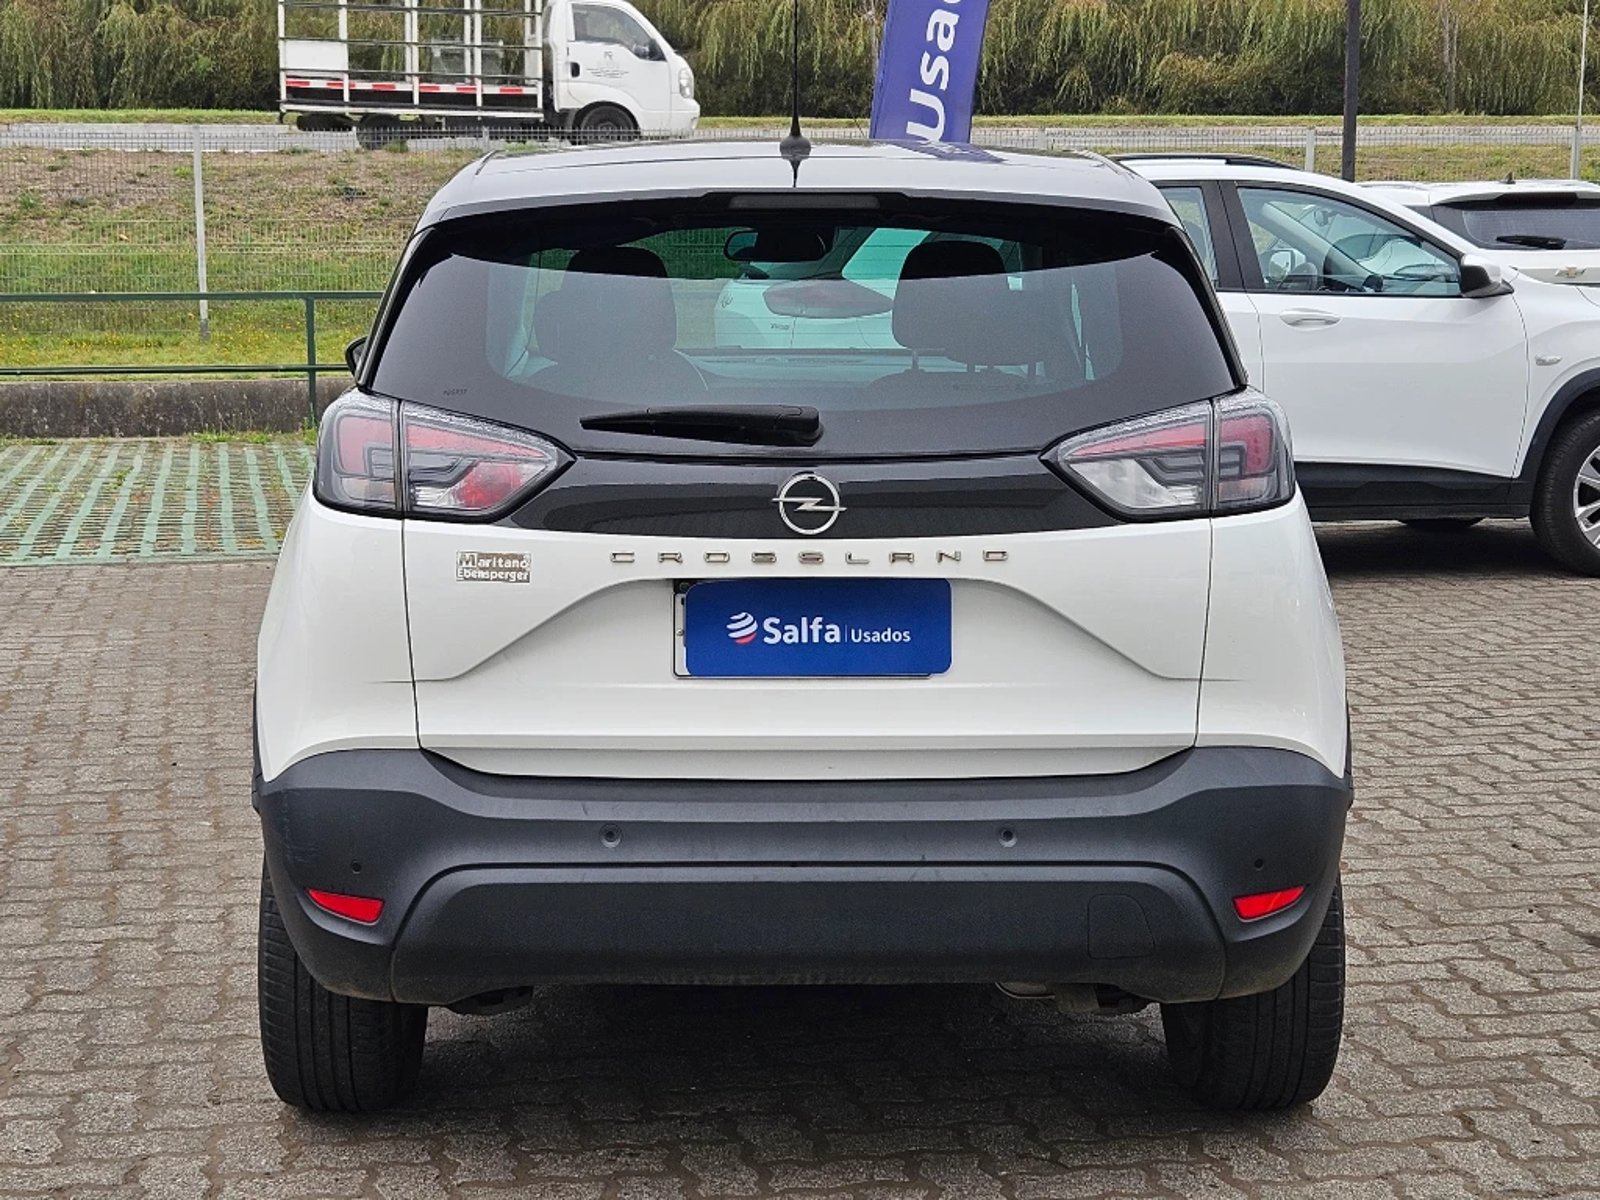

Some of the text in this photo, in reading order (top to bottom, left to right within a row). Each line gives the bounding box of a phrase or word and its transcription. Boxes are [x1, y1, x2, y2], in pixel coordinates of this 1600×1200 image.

[906, 0, 960, 142] Usa
[610, 550, 1009, 564] CROSSLAND
[763, 617, 911, 644] Salfa Usados
